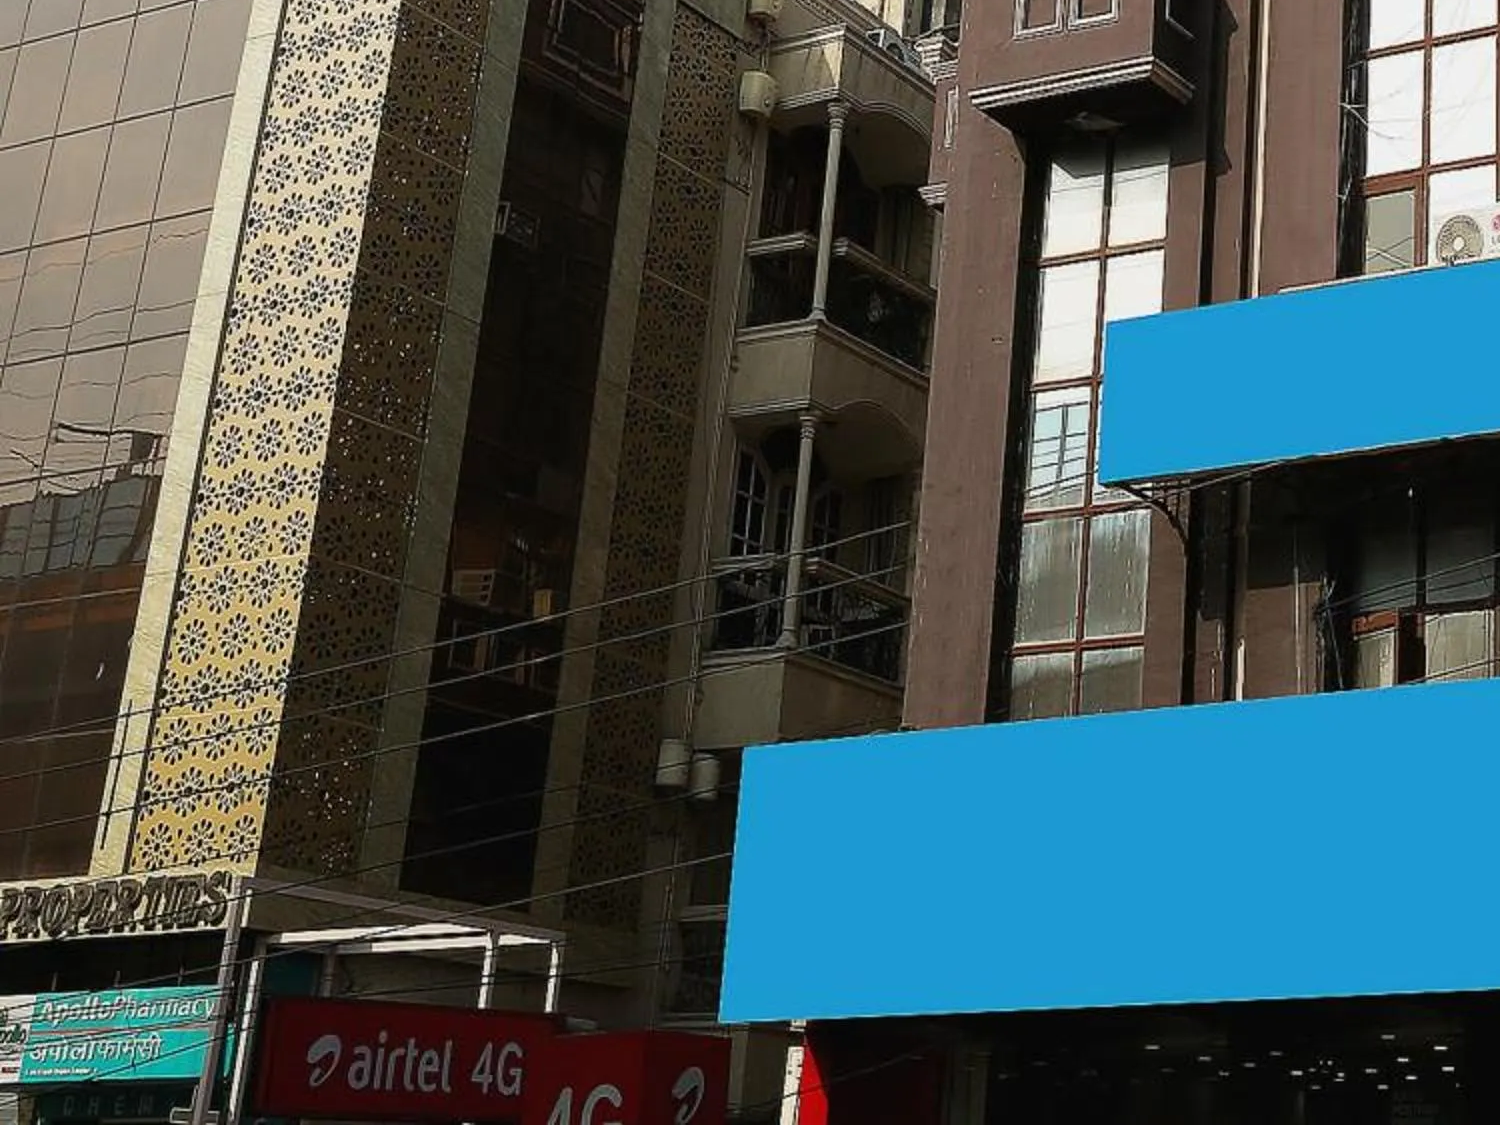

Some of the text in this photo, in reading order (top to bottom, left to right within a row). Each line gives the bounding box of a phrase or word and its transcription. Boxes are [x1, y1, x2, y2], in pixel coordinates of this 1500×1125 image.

[0, 871, 231, 939] PROPERTIES
[347, 1029, 524, 1096] airtel 4G
